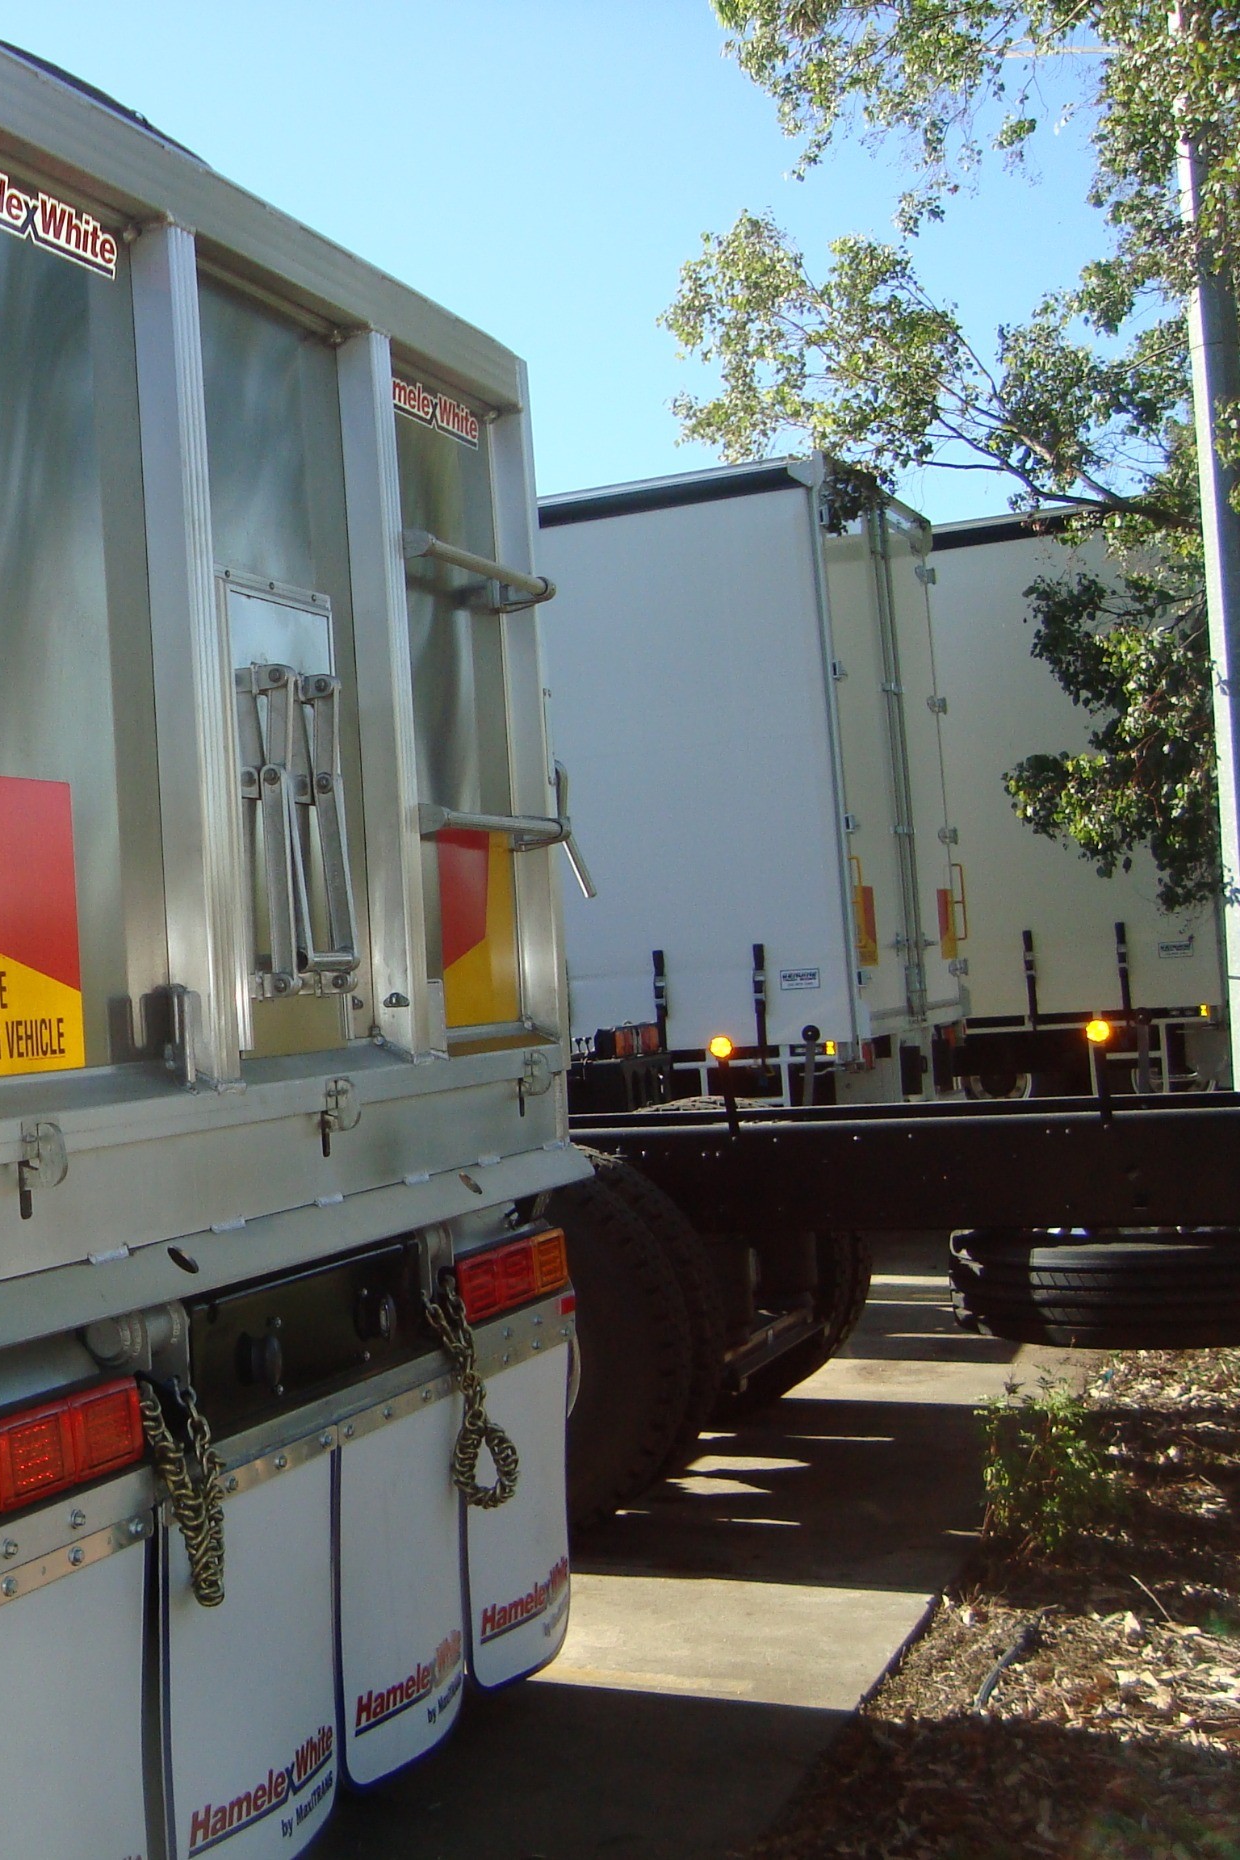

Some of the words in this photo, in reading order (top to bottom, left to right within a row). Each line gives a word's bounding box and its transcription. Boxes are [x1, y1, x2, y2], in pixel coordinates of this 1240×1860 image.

[393, 380, 478, 440] melexWhite
[5, 1017, 66, 1059] VEHICLE
[189, 1725, 333, 1849] HamelexWhite
[281, 1819, 293, 1838] by
